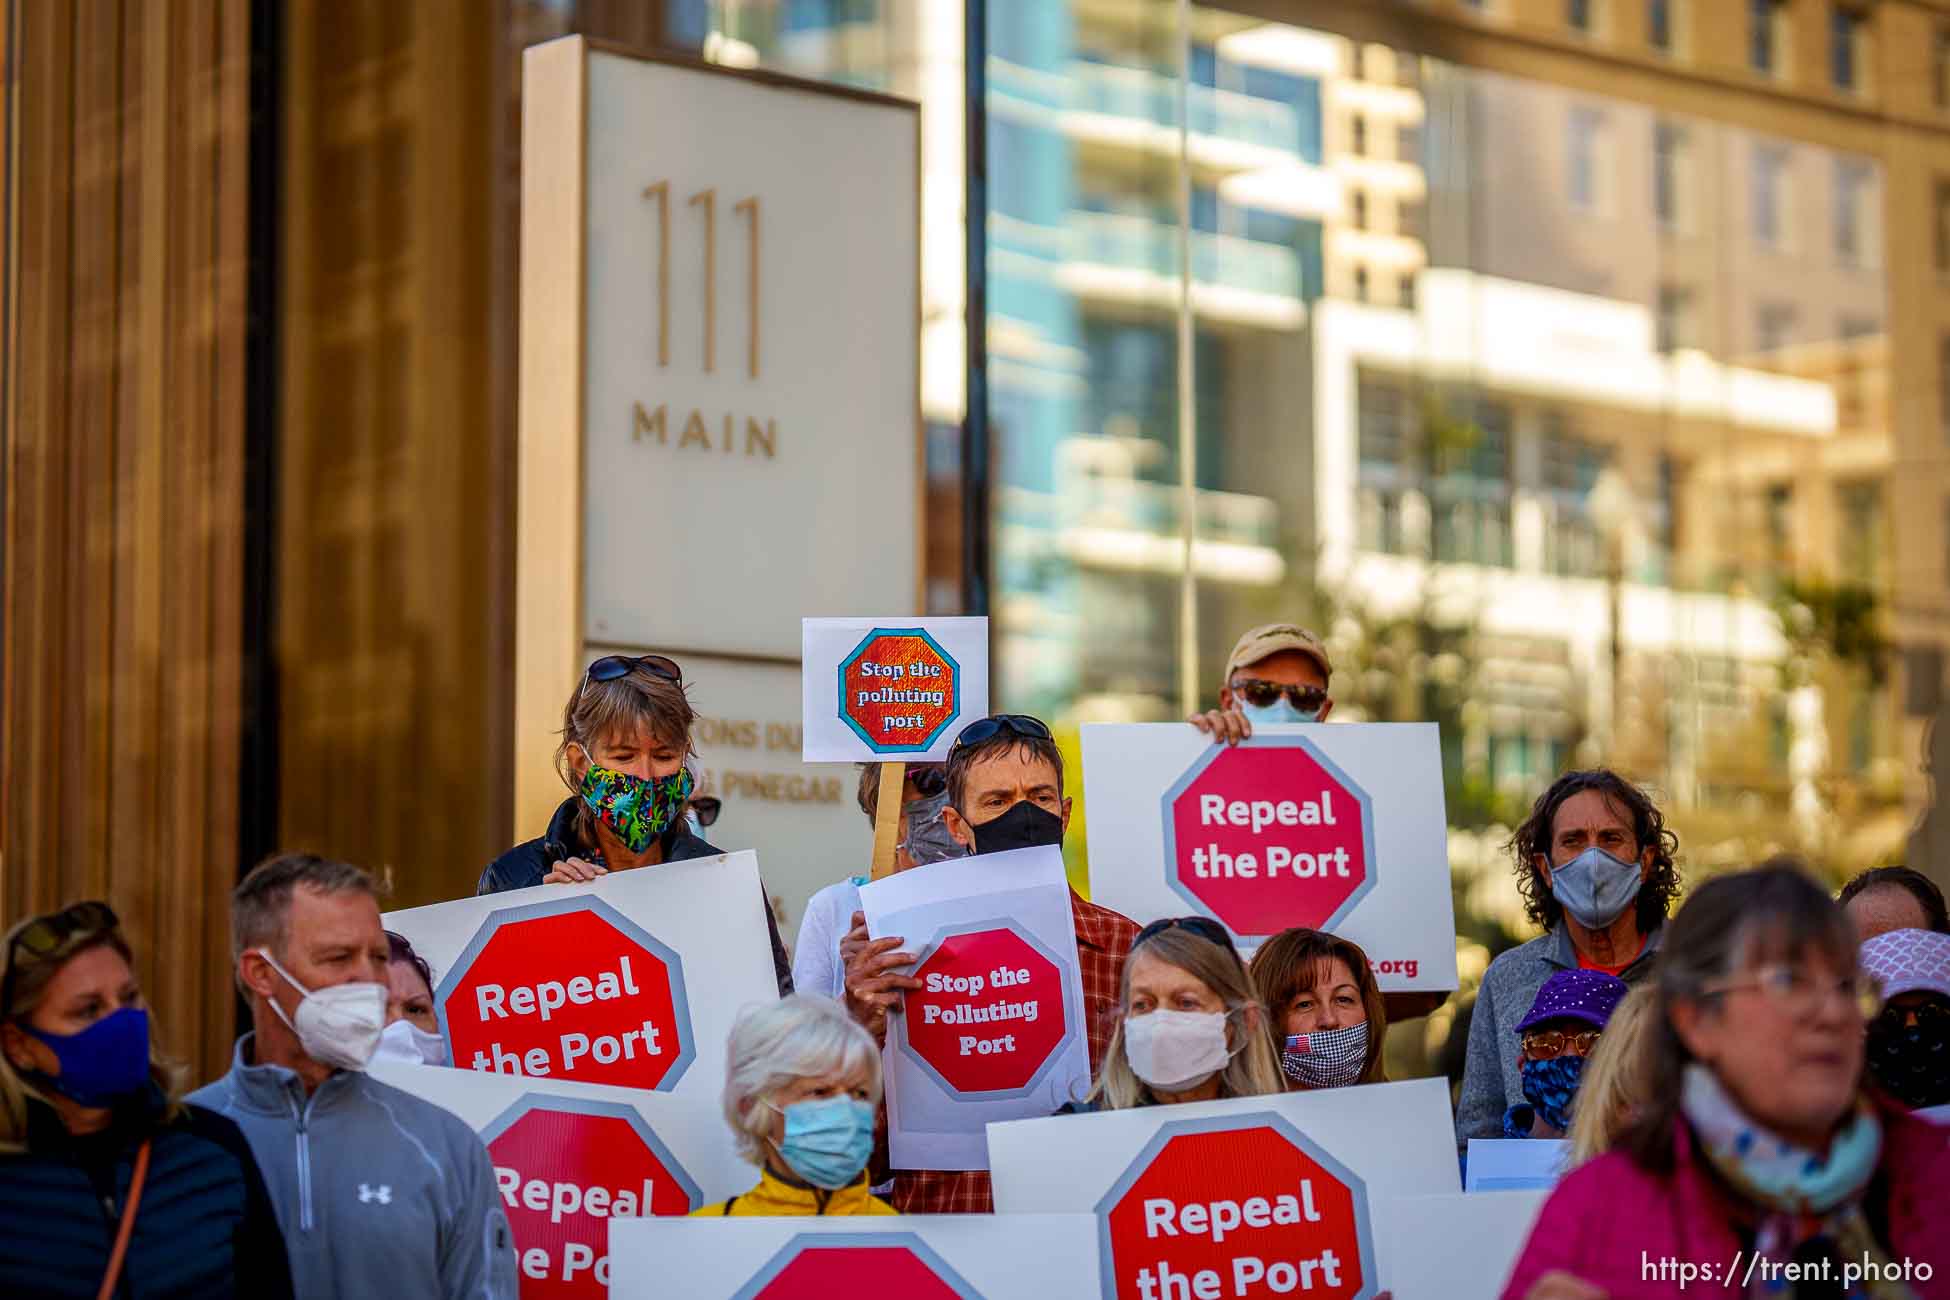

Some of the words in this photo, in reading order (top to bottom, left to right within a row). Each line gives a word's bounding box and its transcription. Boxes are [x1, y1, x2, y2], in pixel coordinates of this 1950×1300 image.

[640, 179, 761, 379] 111
[630, 400, 776, 458] MAIN
[861, 662, 904, 680] Stop
[909, 661, 941, 676] the
[857, 687, 944, 706] polluting
[883, 714, 924, 731] port
[722, 769, 842, 803] PINEGAR
[1200, 790, 1336, 833] Repeal
[1192, 843, 1257, 878] the
[1266, 846, 1350, 878] Port
[475, 956, 640, 1022] Repeal
[926, 973, 984, 996] Stop
[990, 966, 1030, 988] the
[924, 1000, 1038, 1024] Polluting
[472, 1043, 551, 1076] the
[560, 1021, 662, 1071] Port
[959, 1034, 1016, 1055] Port
[493, 1166, 656, 1223] Repeal
[1144, 1179, 1321, 1243] Repeal
[1136, 1261, 1222, 1300] the
[1232, 1249, 1342, 1297] Port
